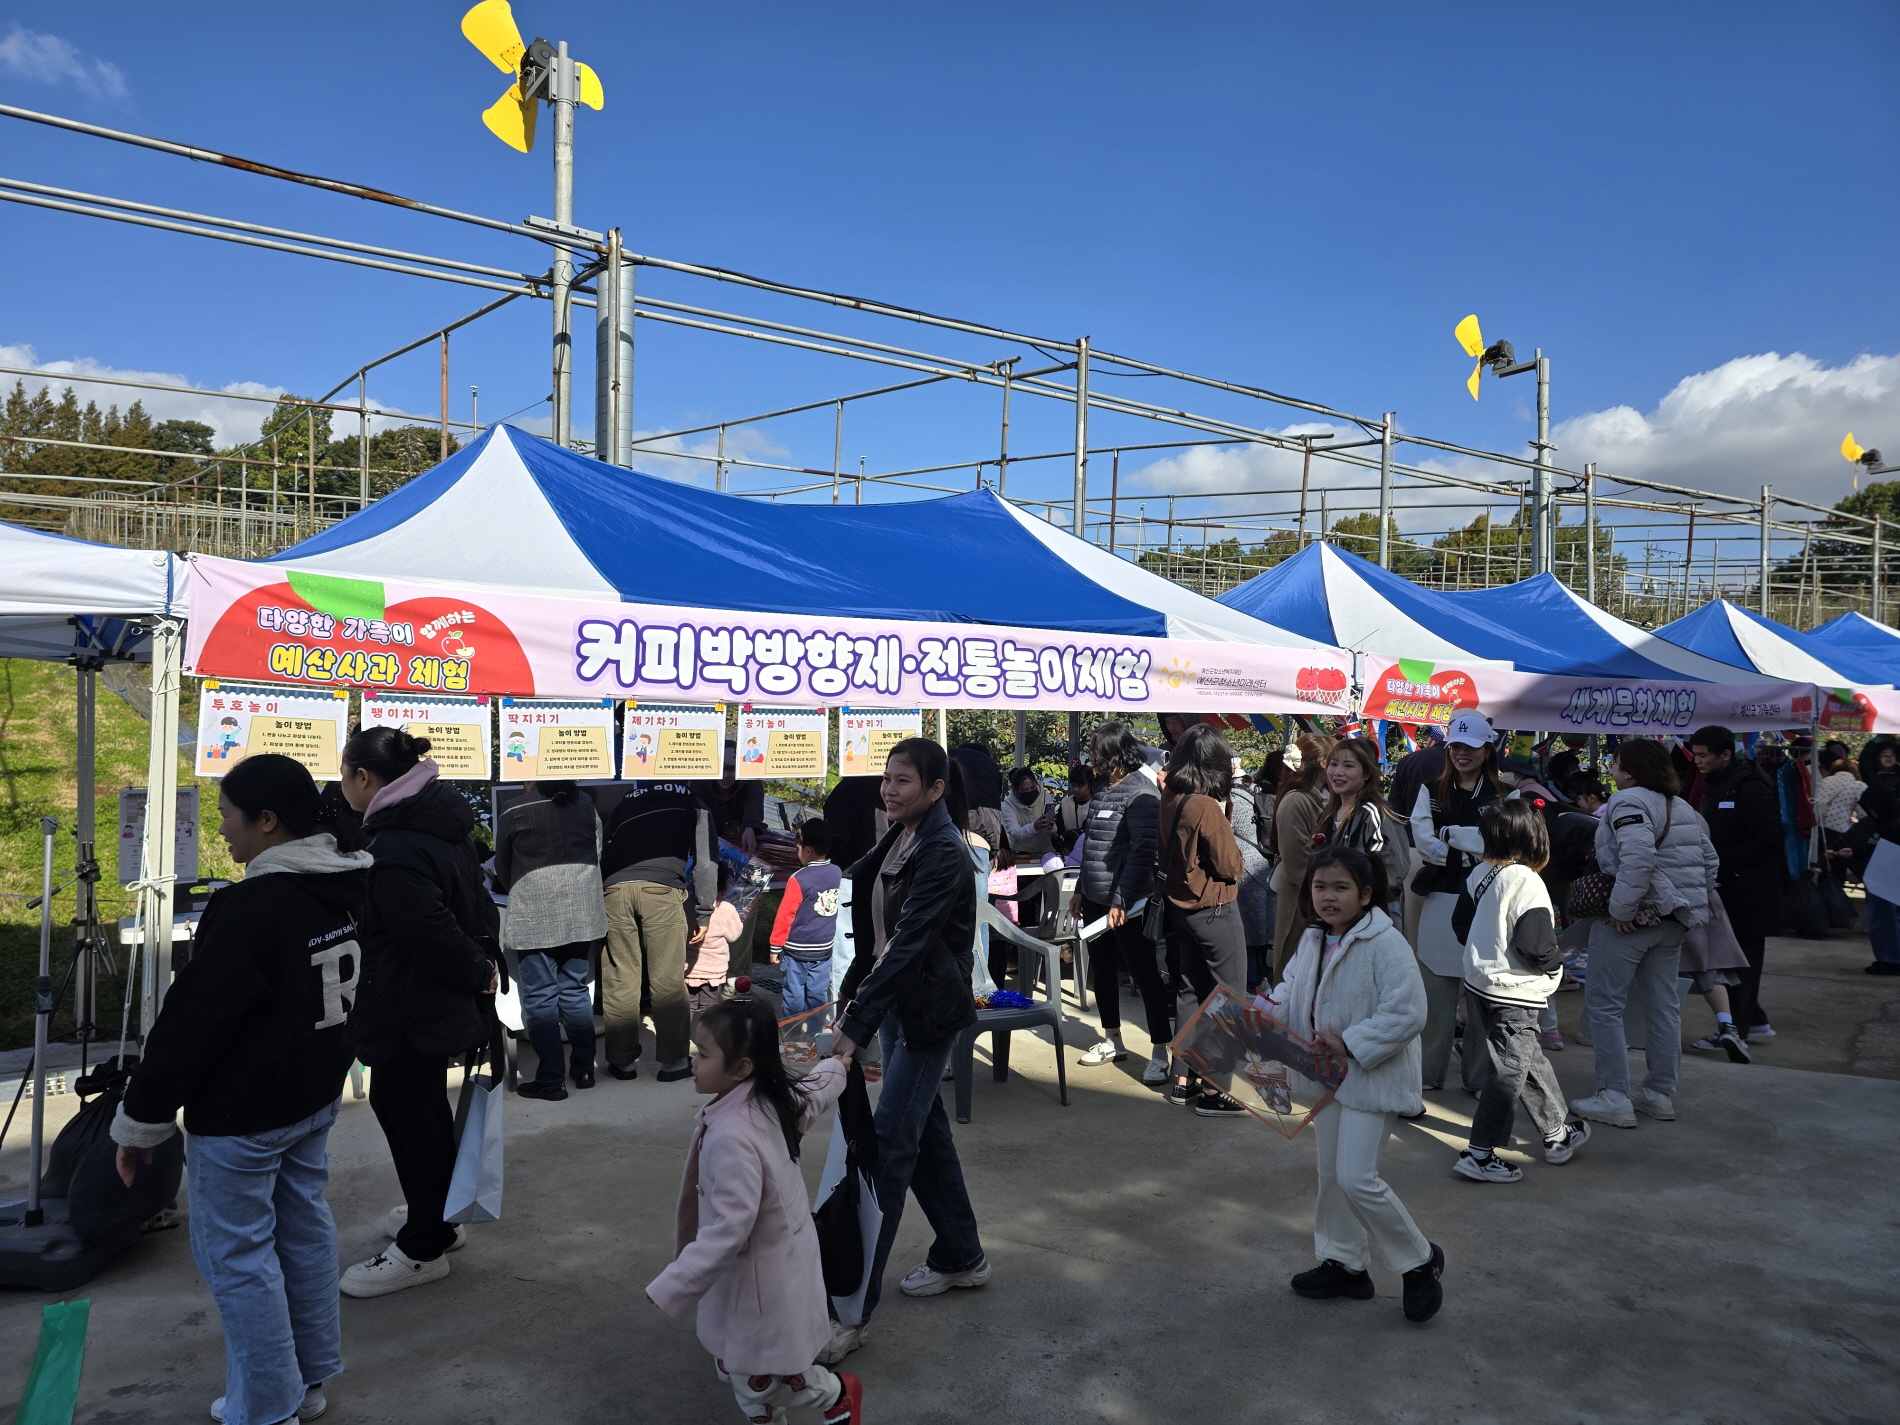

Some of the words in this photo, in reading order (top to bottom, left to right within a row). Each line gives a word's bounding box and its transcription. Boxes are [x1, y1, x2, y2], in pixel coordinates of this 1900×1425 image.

[257, 606, 335, 640] 다양한
[343, 616, 415, 646] 가족이
[419, 610, 476, 638] 함께하는
[269, 645, 402, 684] 예산사과
[410, 657, 472, 693] 체험
[1386, 679, 1414, 697] 다양한
[1414, 682, 1441, 699] 가족이
[211, 698, 279, 714] 투호놀이
[1384, 699, 1431, 720] 예산사과
[1430, 703, 1455, 722] 체험
[1560, 686, 1697, 727] 세계문화체험
[370, 707, 429, 720] 팽이치기
[508, 713, 560, 724] 딱지치기
[274, 720, 292, 730] 놀이
[294, 721, 312, 731] 방법
[631, 716, 679, 726] 제기차기
[744, 719, 786, 729] 공기놀이
[846, 719, 883, 729] 연날리기
[1458, 720, 1469, 732] LA
